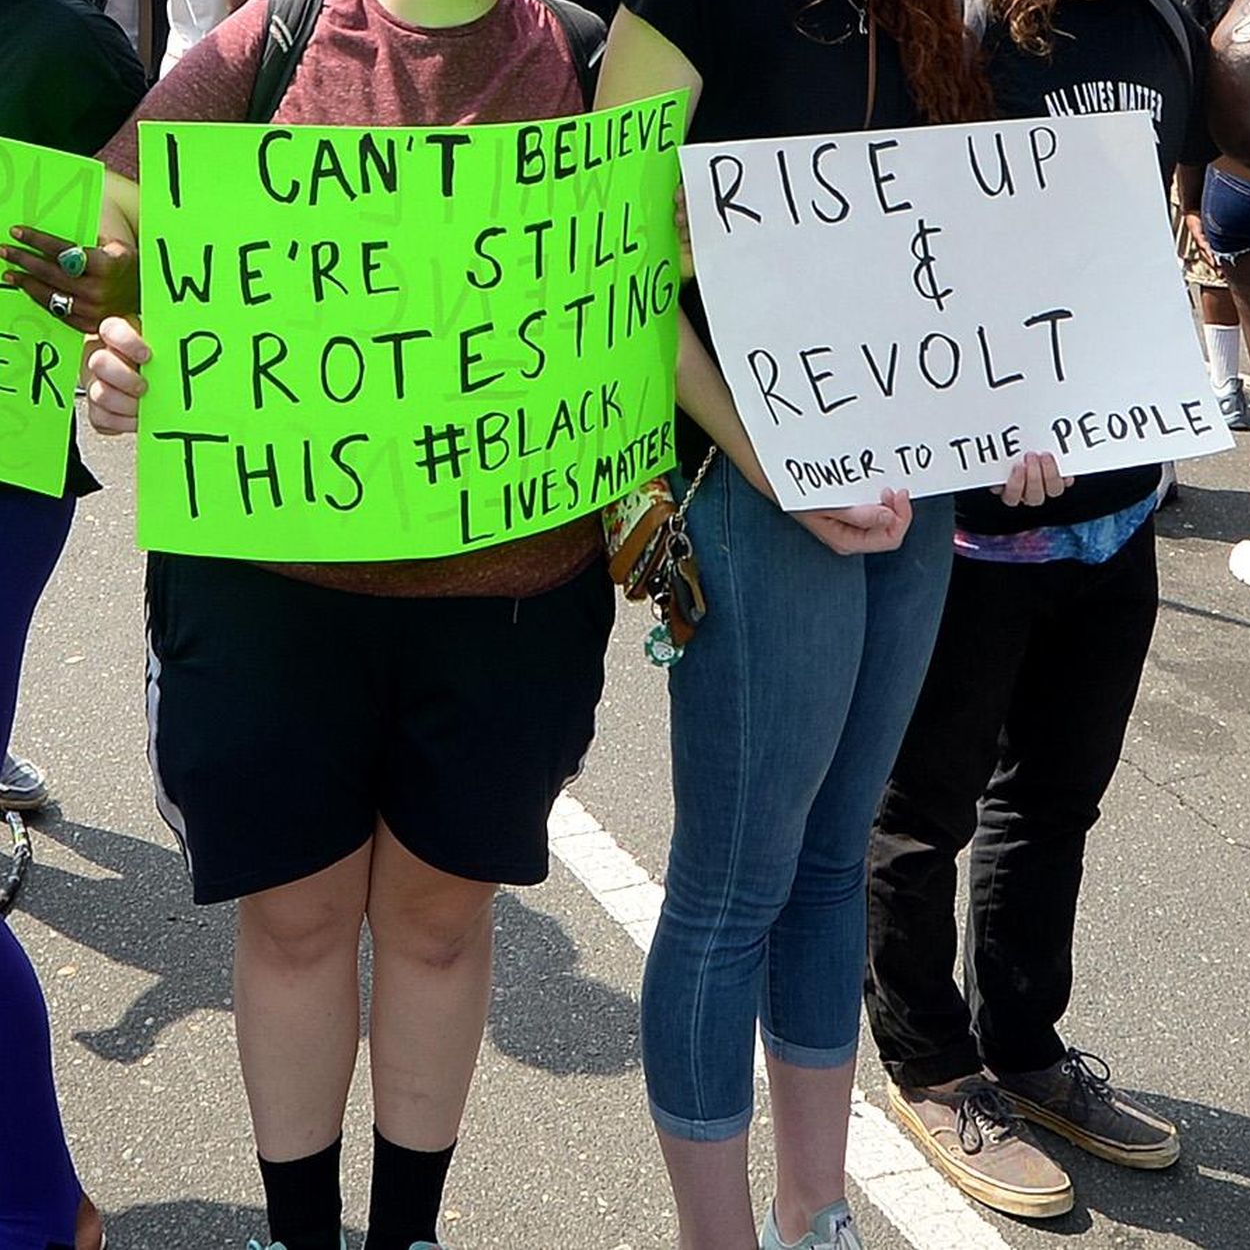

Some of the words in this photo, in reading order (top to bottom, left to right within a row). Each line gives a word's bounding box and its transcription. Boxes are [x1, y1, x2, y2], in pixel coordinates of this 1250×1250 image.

[166, 133, 181, 209] I
[257, 129, 472, 206] CAN'T
[515, 100, 678, 186] BELIEVE
[1044, 88, 1075, 118] ALL
[1073, 80, 1115, 114] LIVES
[1118, 81, 1163, 123] MATTER
[709, 138, 912, 233] RISE
[967, 125, 1060, 198] UP
[157, 237, 400, 306] WE'RE
[466, 202, 640, 290] STILL
[179, 259, 674, 412] PROTESTING
[747, 308, 1073, 426] REVOLT
[153, 431, 371, 520] THIS
[413, 379, 624, 485] #BLACK
[459, 468, 579, 545] LIVES
[590, 420, 673, 505] MATTER
[785, 448, 885, 496] POWER
[895, 444, 933, 476] TO
[950, 425, 1021, 471] THE
[1051, 400, 1212, 456] PEOPLE
